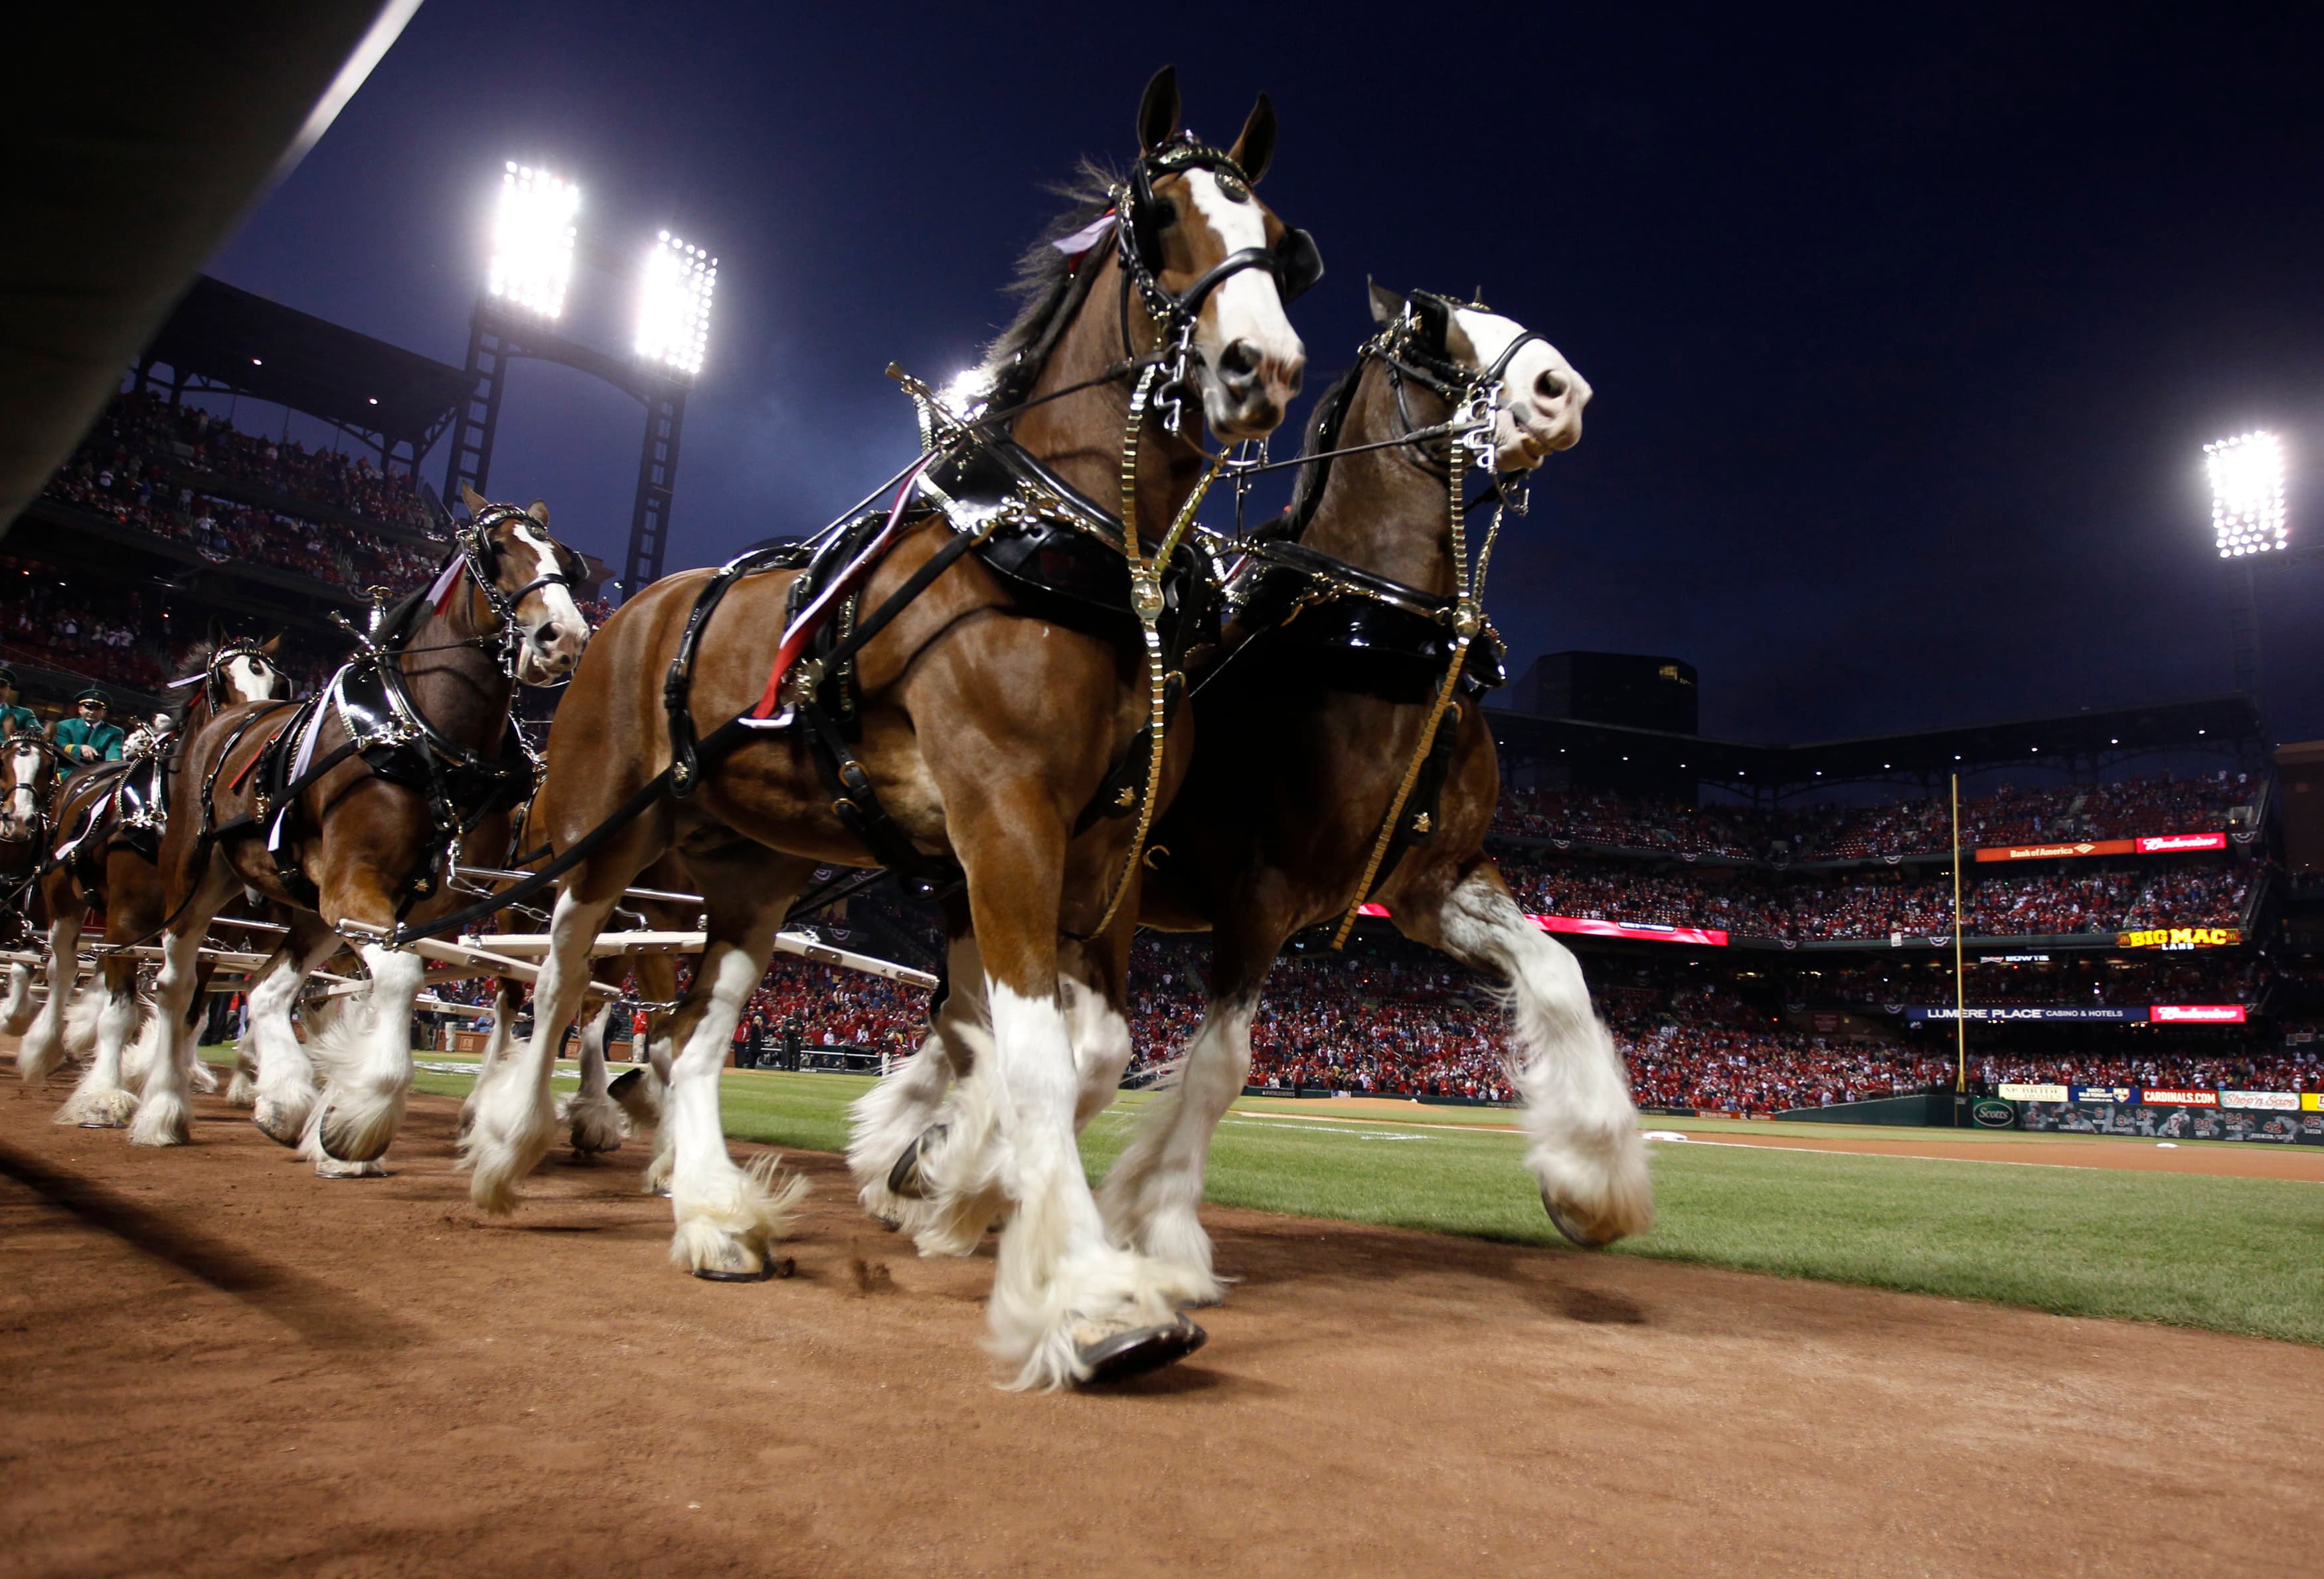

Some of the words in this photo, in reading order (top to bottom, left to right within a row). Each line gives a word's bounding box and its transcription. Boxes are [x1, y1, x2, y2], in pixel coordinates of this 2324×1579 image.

[2010, 849, 2031, 858] Bank
[2031, 848, 2040, 857] of
[2040, 847, 2074, 857] America
[2129, 930, 2168, 947] BIG
[2170, 928, 2227, 945] MAC
[1992, 1009, 2042, 1018] PLACE
[2143, 1091, 2216, 1104] CARDINALS.COM
[2266, 1095, 2295, 1106] Save
[1979, 1107, 2009, 1120] Scotts
[2225, 1112, 2242, 1124] 24
[2167, 1118, 2180, 1129] 17
[2194, 1118, 2210, 1130] 20
[2263, 1121, 2283, 1133] 42
[2303, 1116, 2321, 1128] 45
